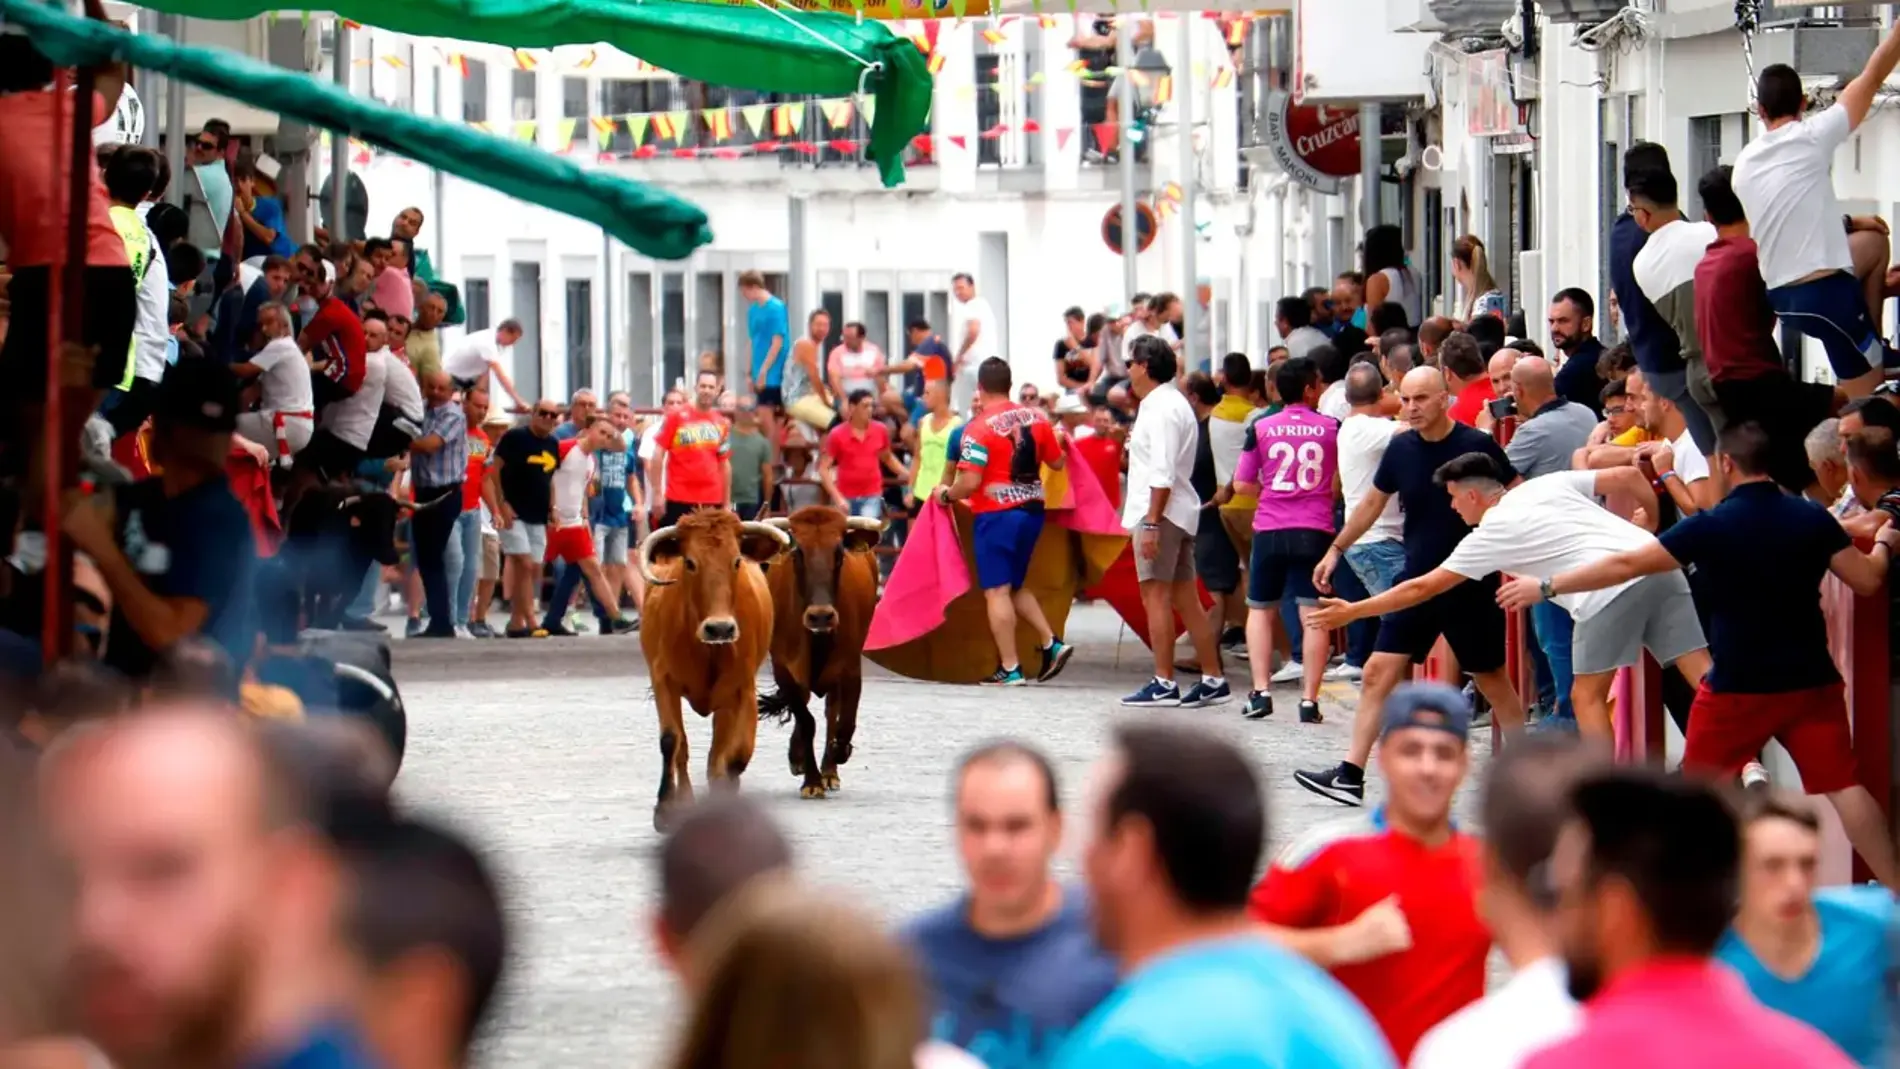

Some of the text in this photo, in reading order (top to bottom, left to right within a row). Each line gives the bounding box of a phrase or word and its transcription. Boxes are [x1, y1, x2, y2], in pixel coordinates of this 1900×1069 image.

[1268, 112, 1318, 186] BAR MAKOKI
[1266, 425, 1325, 437] AFRIDO
[1268, 441, 1324, 491] 28
